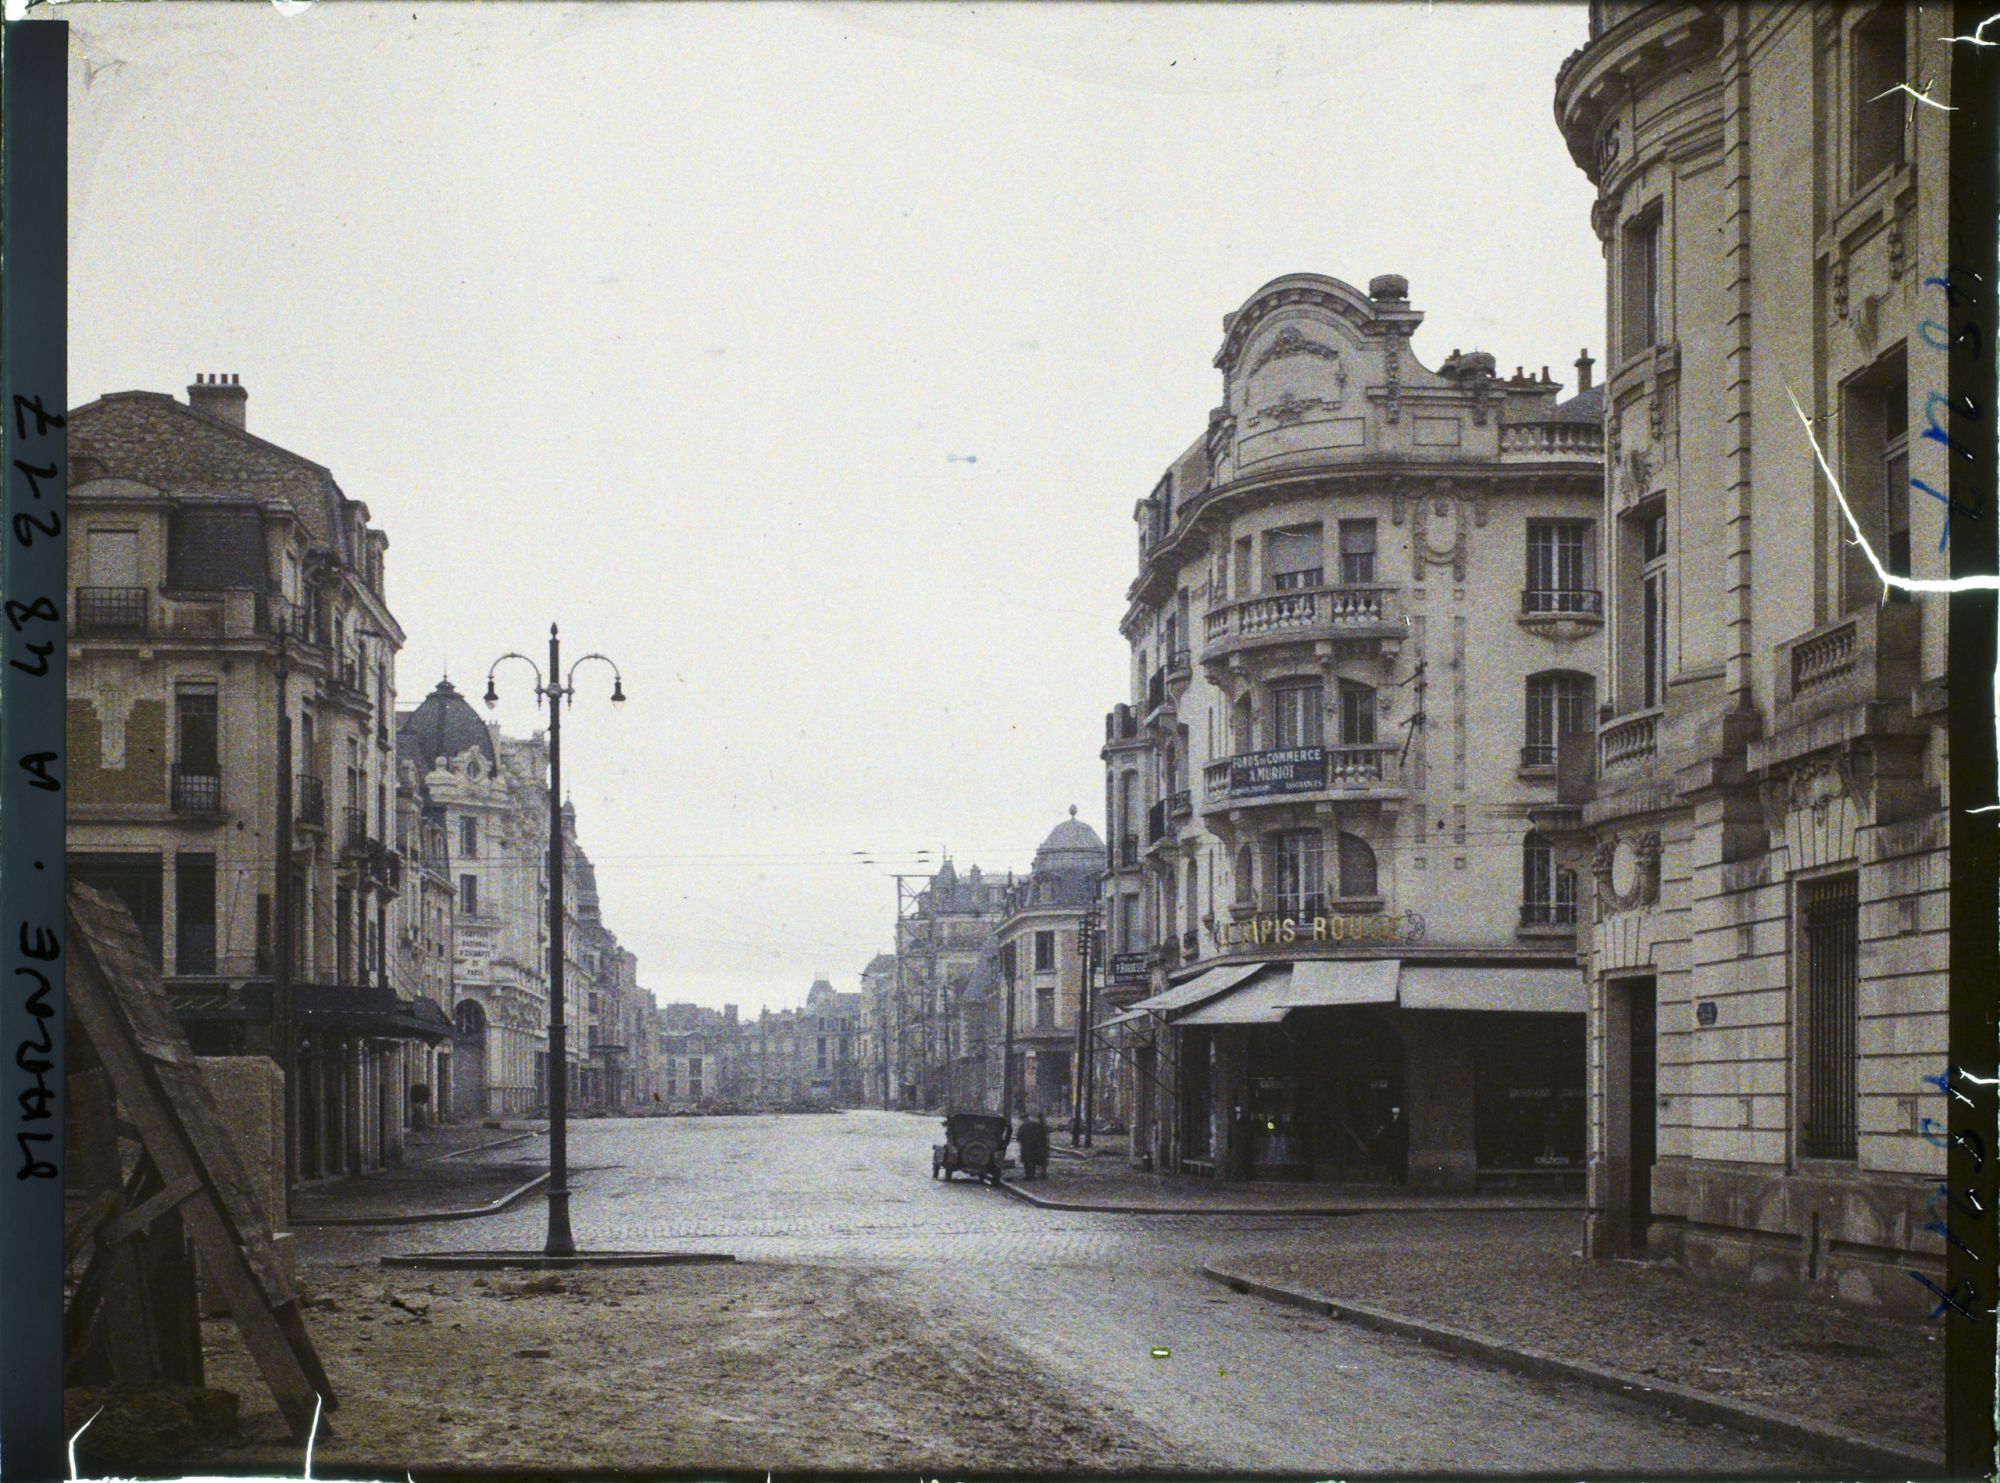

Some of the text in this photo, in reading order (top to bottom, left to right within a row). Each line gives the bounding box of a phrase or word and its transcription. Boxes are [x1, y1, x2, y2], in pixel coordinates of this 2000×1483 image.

[1232, 754, 1260, 769] FONDS
[1266, 749, 1321, 764] COMMERCE
[5, 393, 67, 1181] MARNE A 48 217
[1313, 915, 1400, 942] ROUGE
